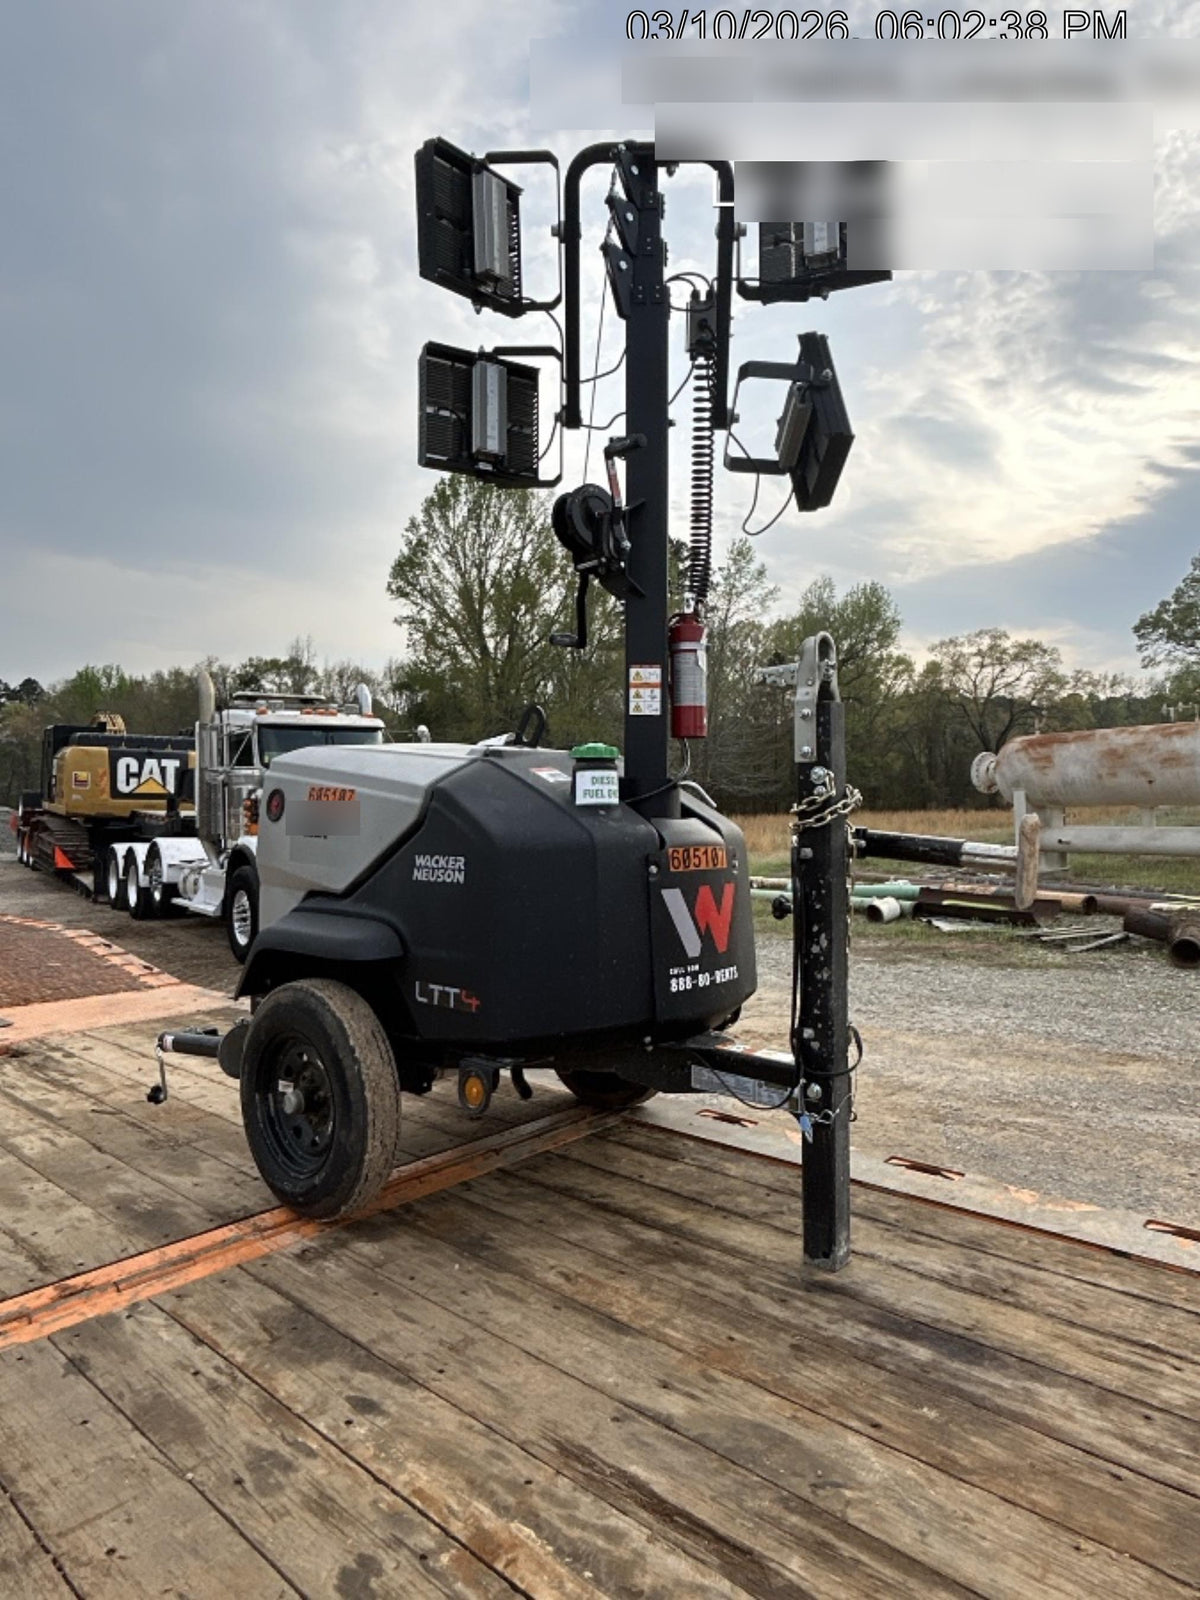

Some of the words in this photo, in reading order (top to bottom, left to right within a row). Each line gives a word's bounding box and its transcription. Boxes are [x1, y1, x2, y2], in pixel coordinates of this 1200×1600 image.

[116, 757, 180, 794] CAT
[583, 789, 605, 799] FUEL
[415, 855, 465, 870] WACKER
[671, 847, 725, 870] 605107
[412, 869, 465, 884] NEUSON
[415, 981, 480, 1013] LTT4
